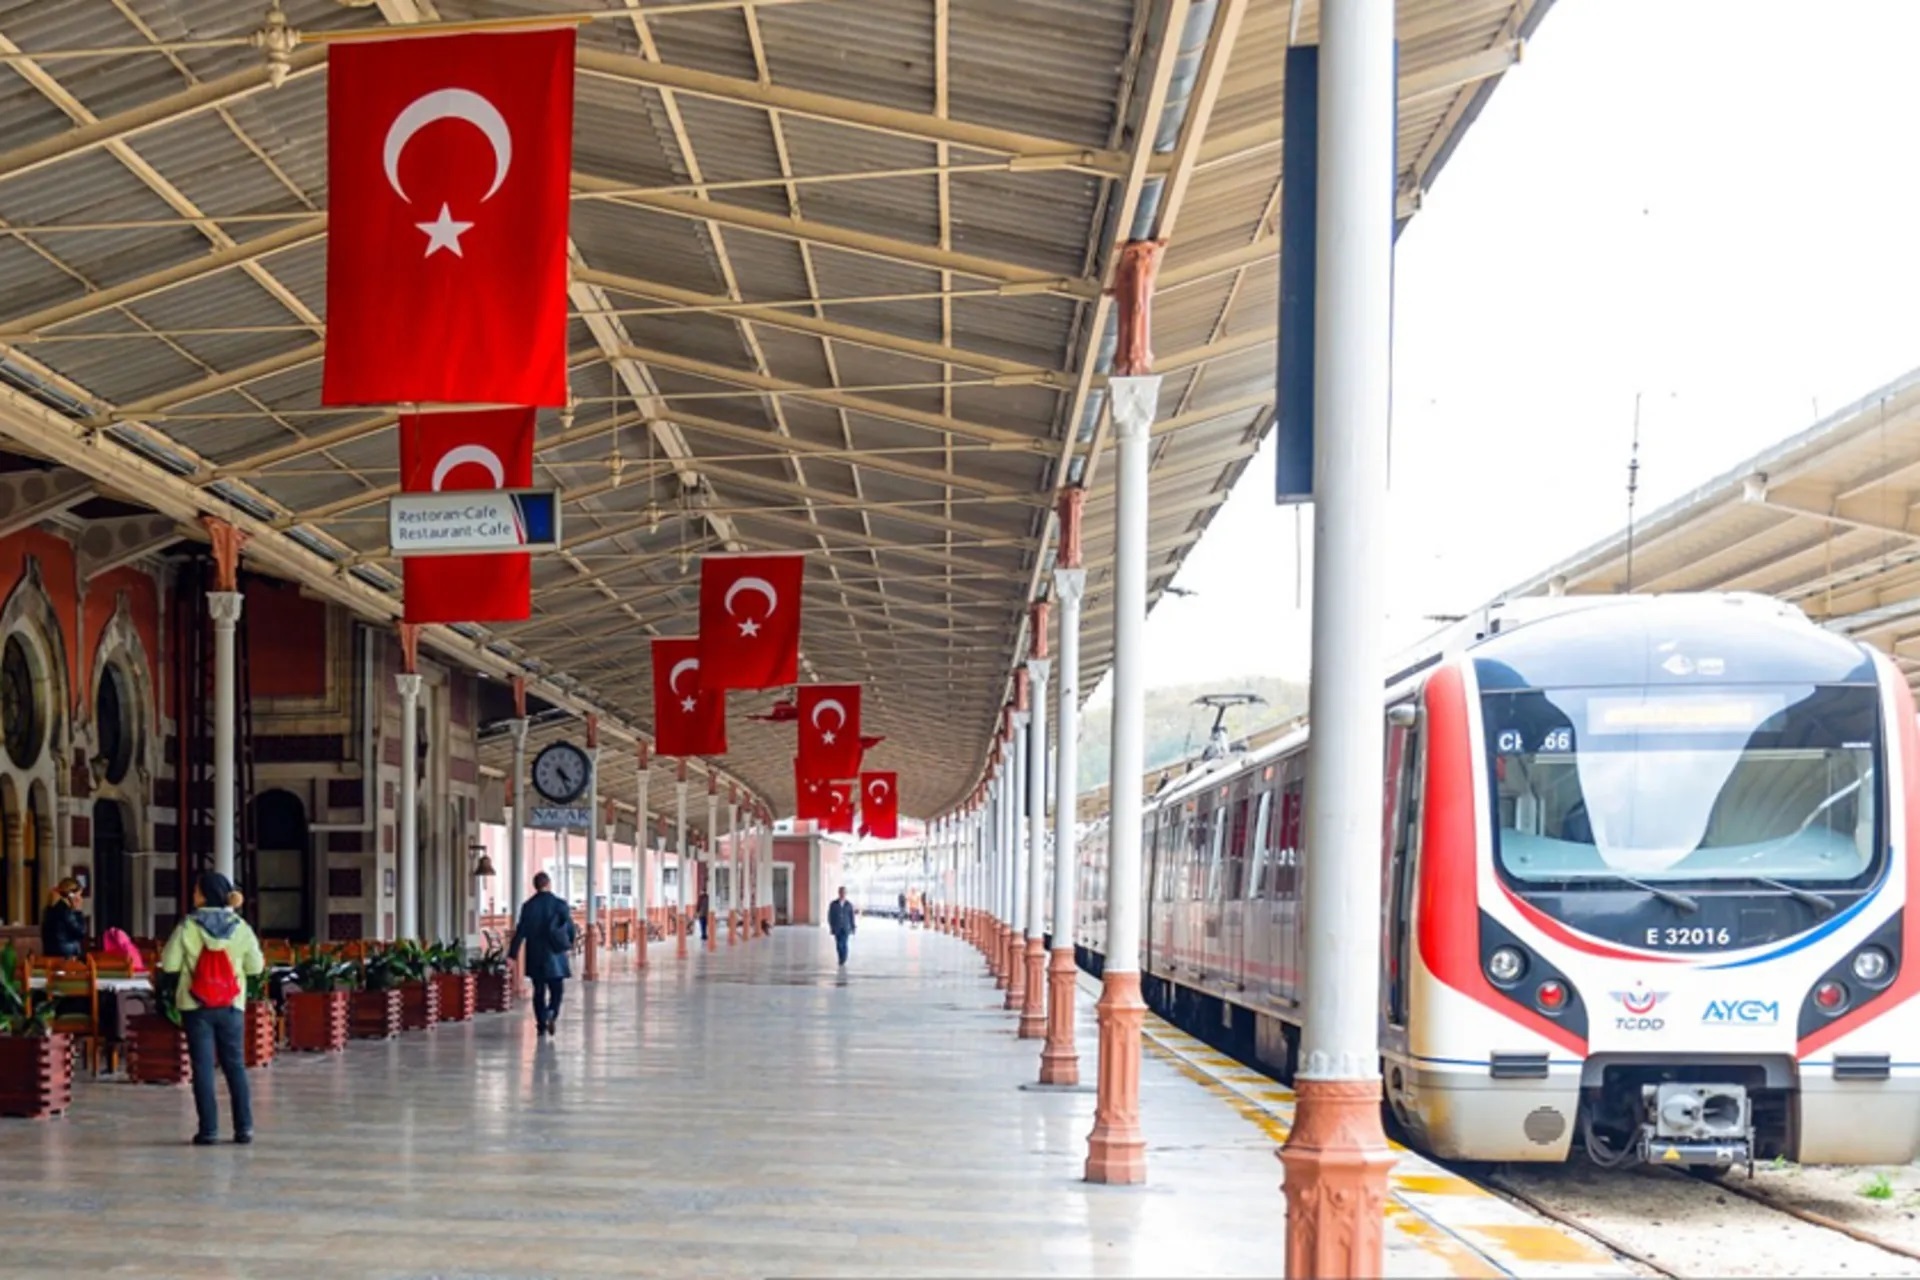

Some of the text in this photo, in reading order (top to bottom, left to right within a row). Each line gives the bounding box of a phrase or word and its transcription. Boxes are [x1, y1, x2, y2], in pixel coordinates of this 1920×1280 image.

[398, 505, 497, 524] Restoran-Cafe
[399, 520, 512, 541] Restaurant-Cafe
[1646, 928, 1731, 945] E 32016
[1615, 1017, 1665, 1031] TCDD
